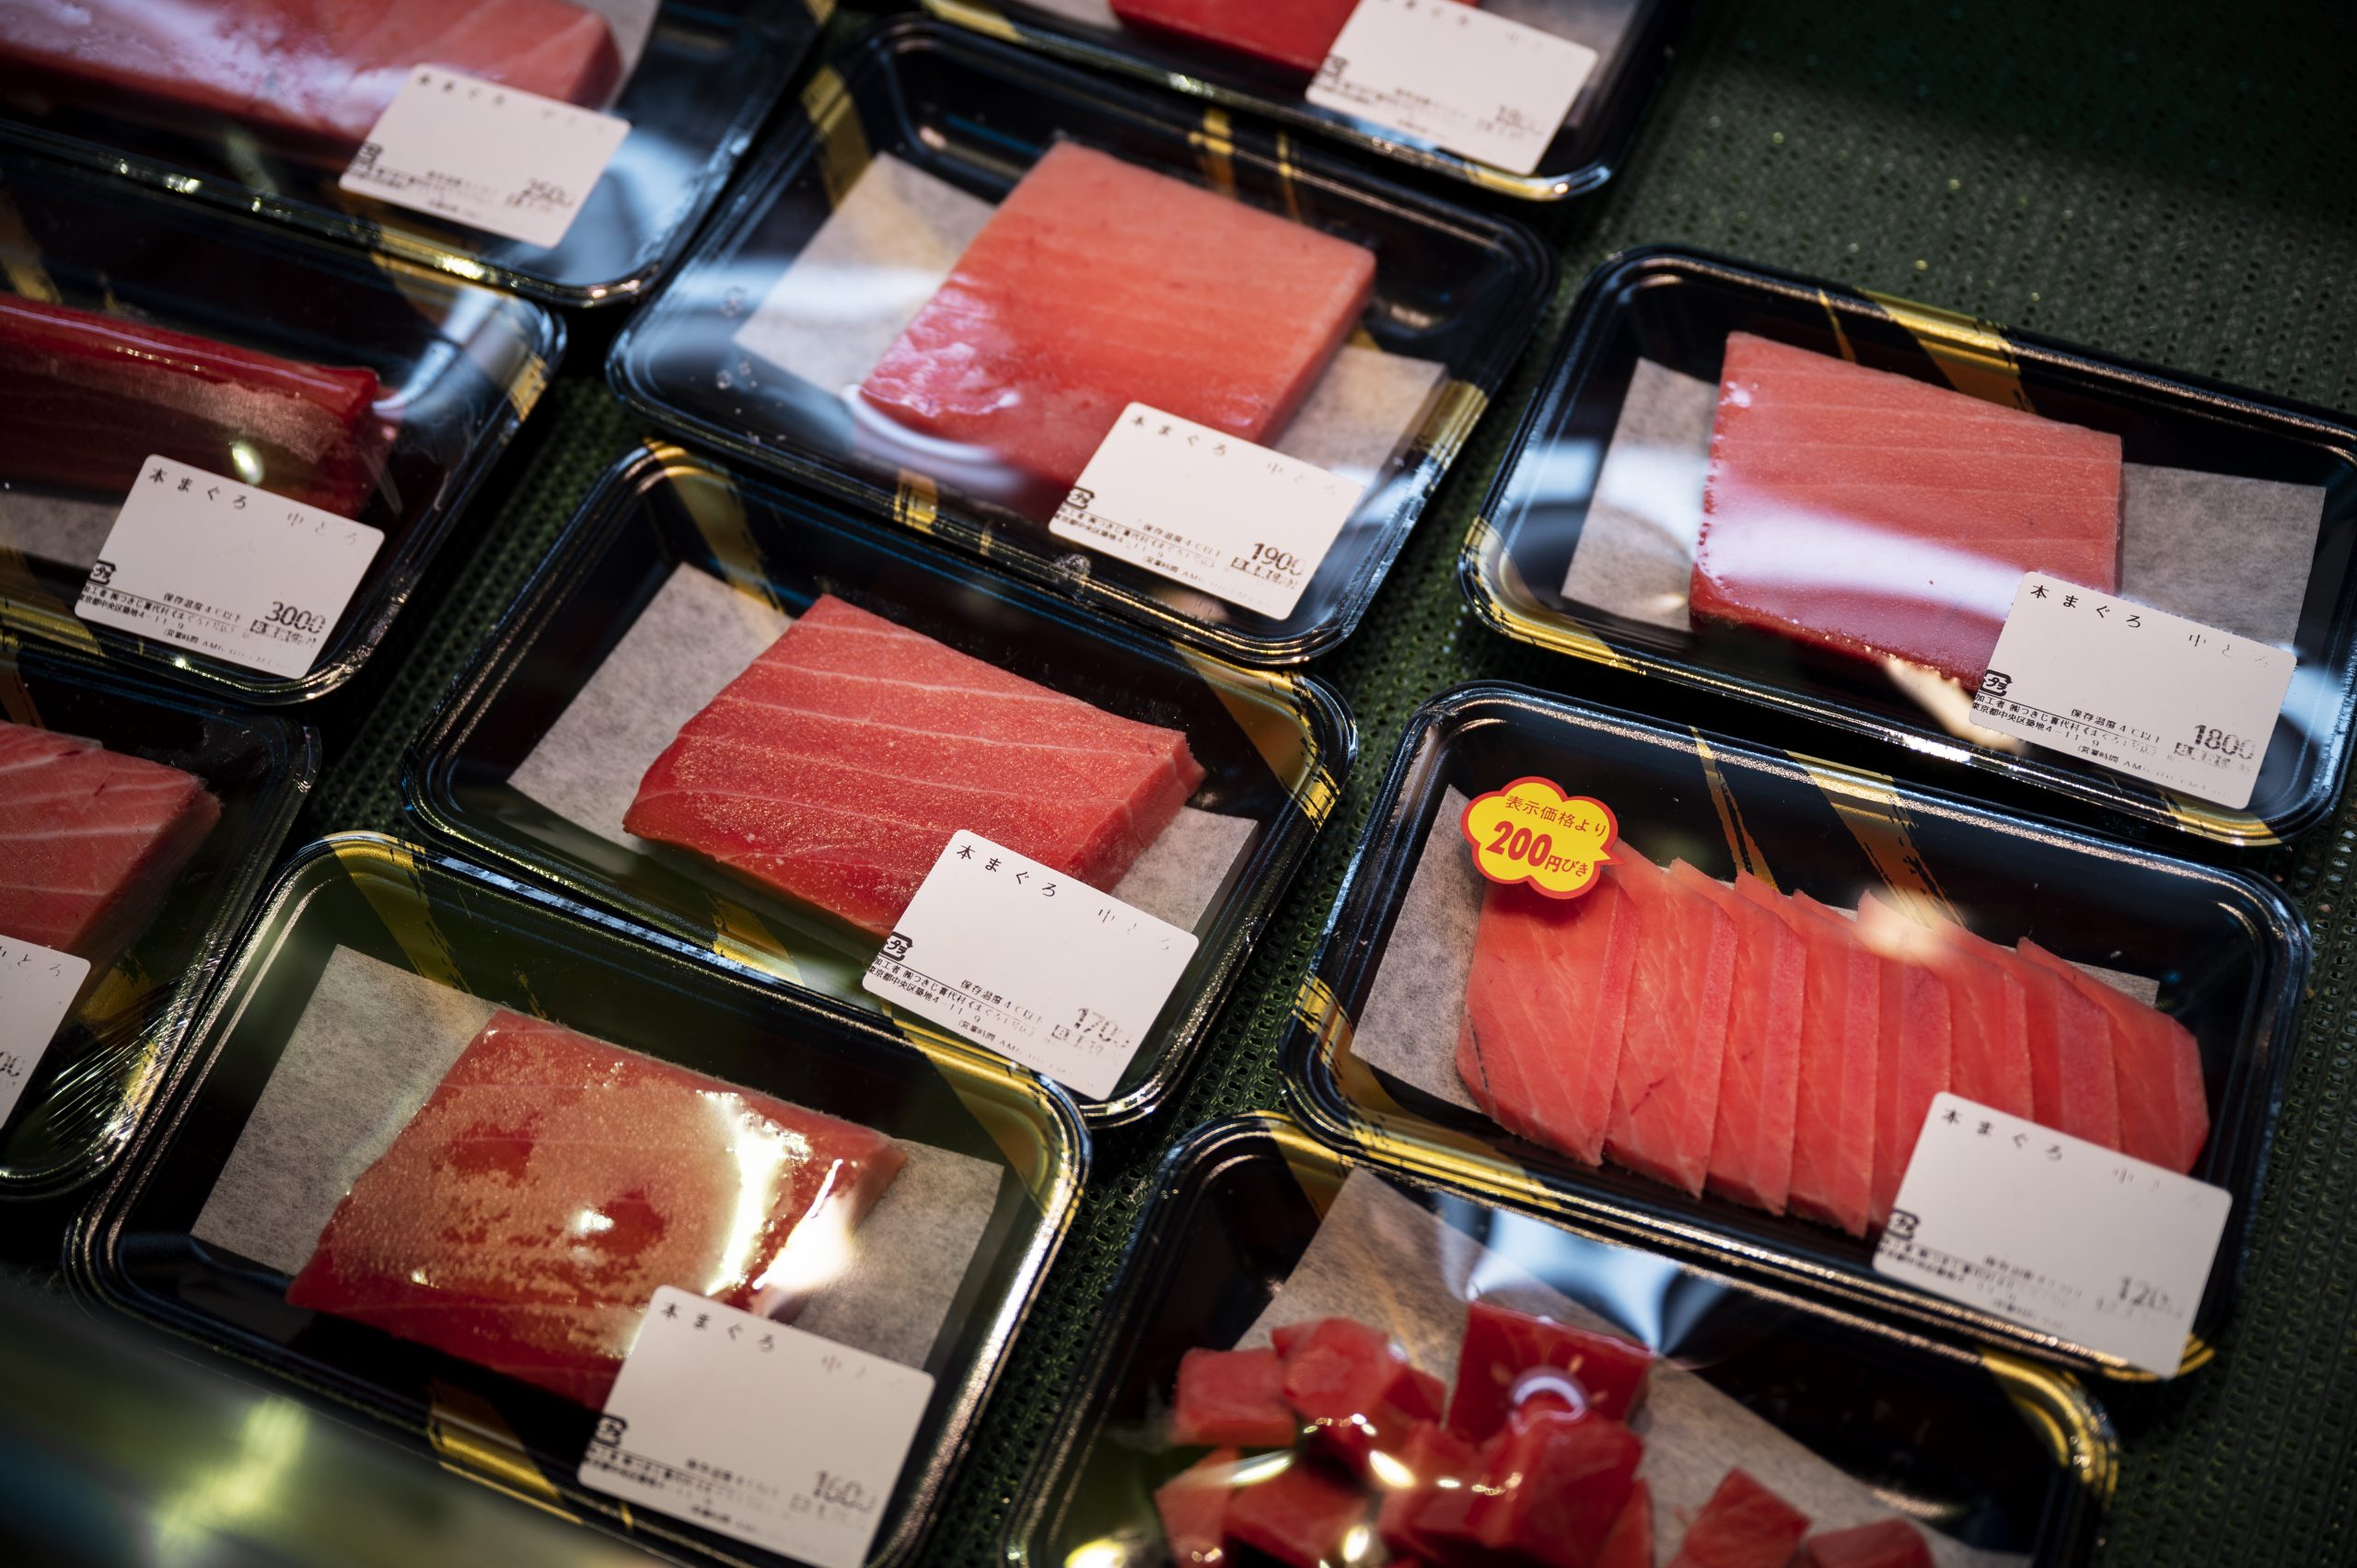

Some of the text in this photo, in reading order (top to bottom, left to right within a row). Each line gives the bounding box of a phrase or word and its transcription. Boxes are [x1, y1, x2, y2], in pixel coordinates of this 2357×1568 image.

[1131, 415, 1226, 456] 本まぐろ
[149, 467, 248, 509] 本まぐろ
[265, 601, 326, 633] 3000
[2030, 585, 2142, 629] 本まぐろ
[2194, 725, 2256, 760] 1800
[1505, 795, 1606, 837] 表示価格より
[1485, 820, 1588, 877] 200円びき
[956, 844, 1058, 898] 本まぐろ
